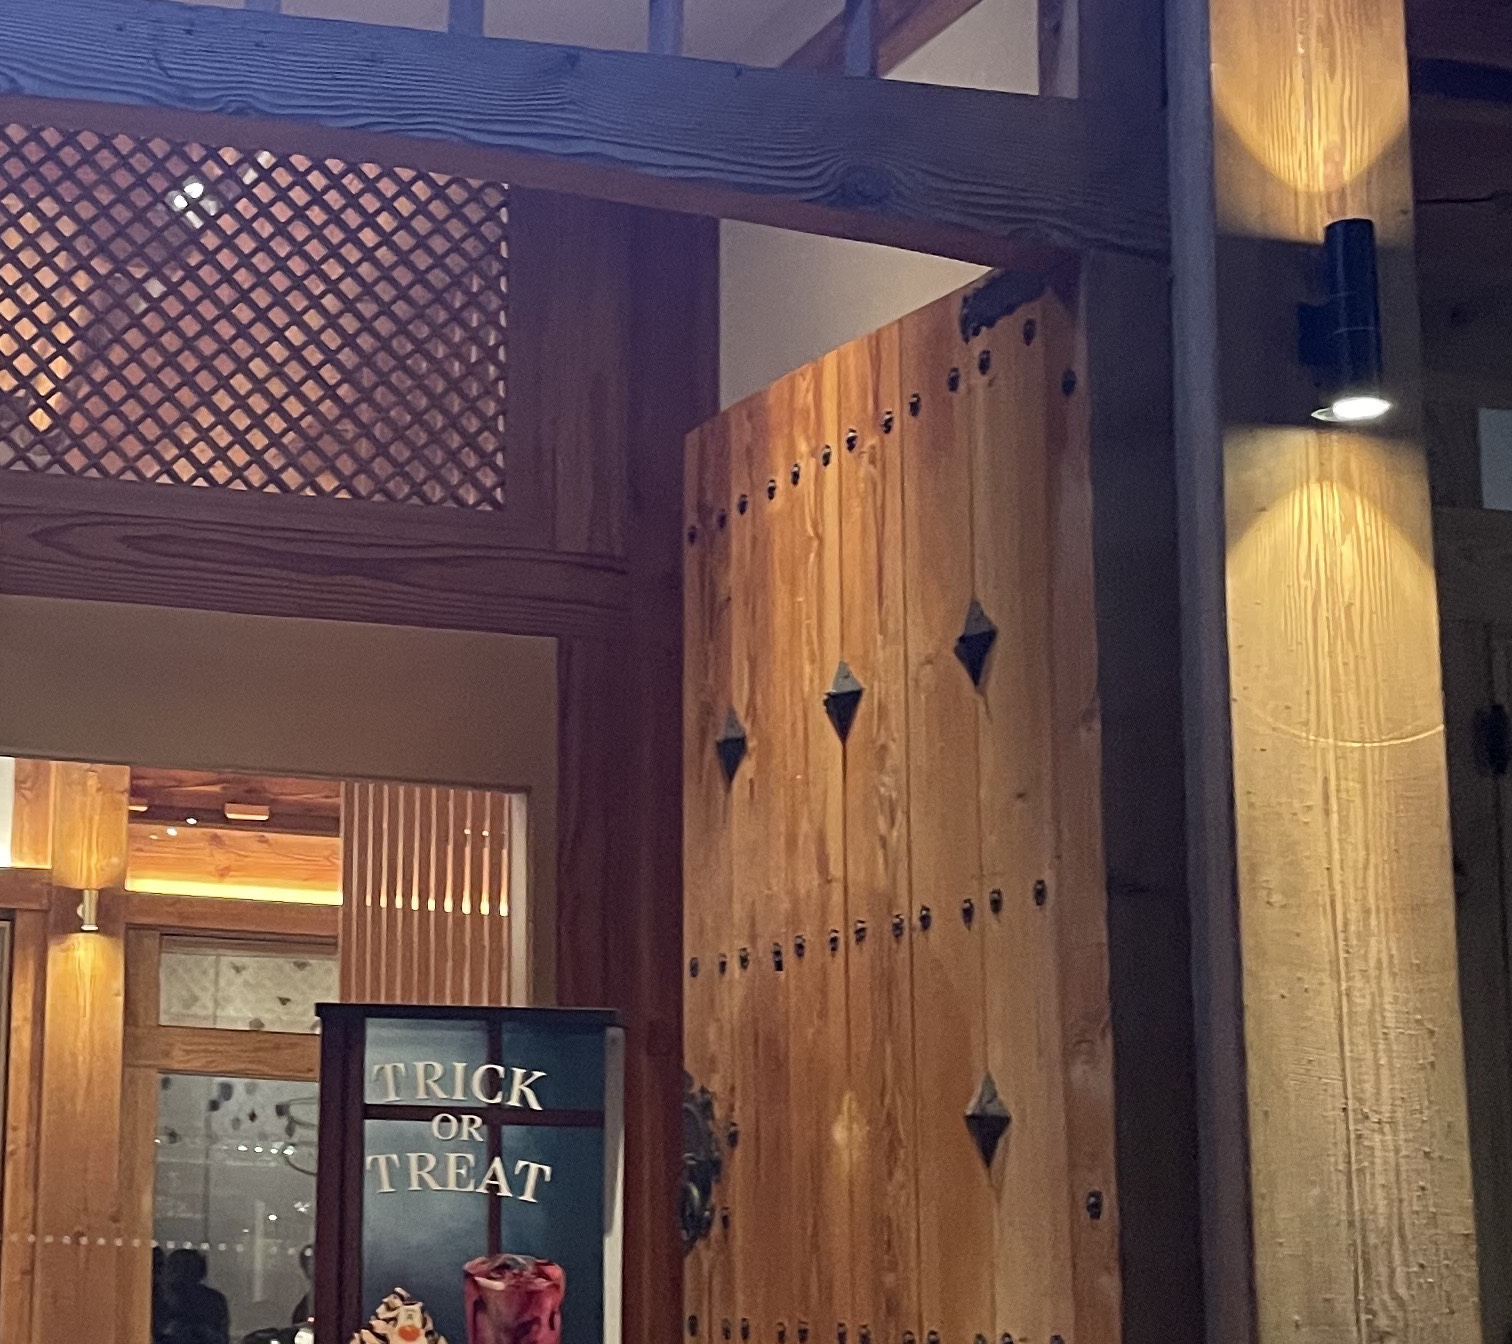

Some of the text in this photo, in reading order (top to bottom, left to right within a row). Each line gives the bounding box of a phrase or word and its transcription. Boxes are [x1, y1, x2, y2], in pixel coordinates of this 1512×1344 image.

[373, 1060, 548, 1111] TRICK
[431, 1112, 485, 1142] OR
[365, 1152, 552, 1203] TREAT
